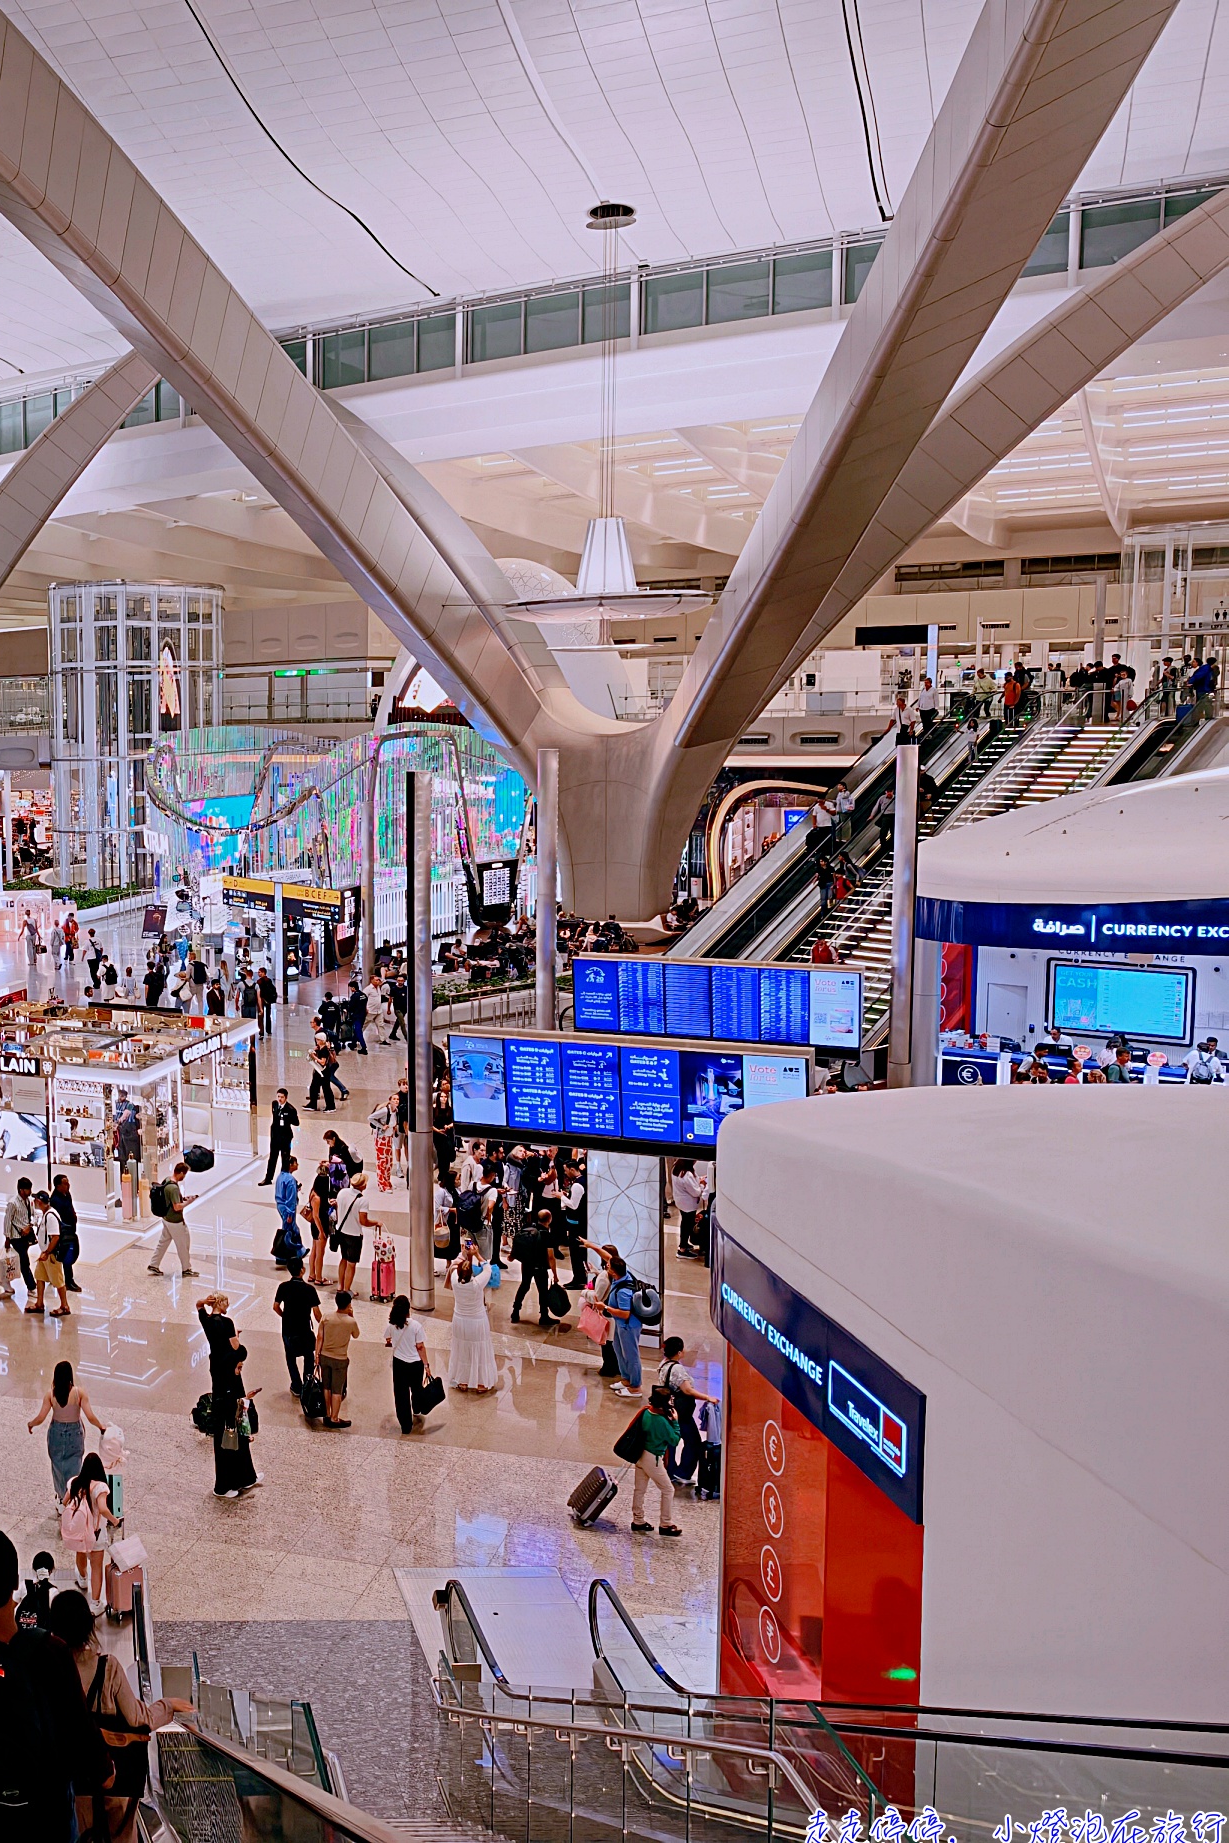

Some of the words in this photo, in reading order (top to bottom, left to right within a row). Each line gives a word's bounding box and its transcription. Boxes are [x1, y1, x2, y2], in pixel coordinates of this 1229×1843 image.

[305, 889, 309, 897] B
[311, 890, 316, 898] C
[1033, 918, 1085, 936] صرافة
[1102, 923, 1193, 937] CURRENCY
[1197, 926, 1229, 938] EXC
[1124, 953, 1186, 963] EANGE
[1058, 977, 1097, 989] CASH
[183, 1035, 221, 1064] GUERLAIN
[749, 1064, 777, 1074] Vote
[721, 1282, 767, 1335] CURRENCY
[767, 1324, 823, 1386] EXCHANGE
[847, 1400, 878, 1442] Travelex
